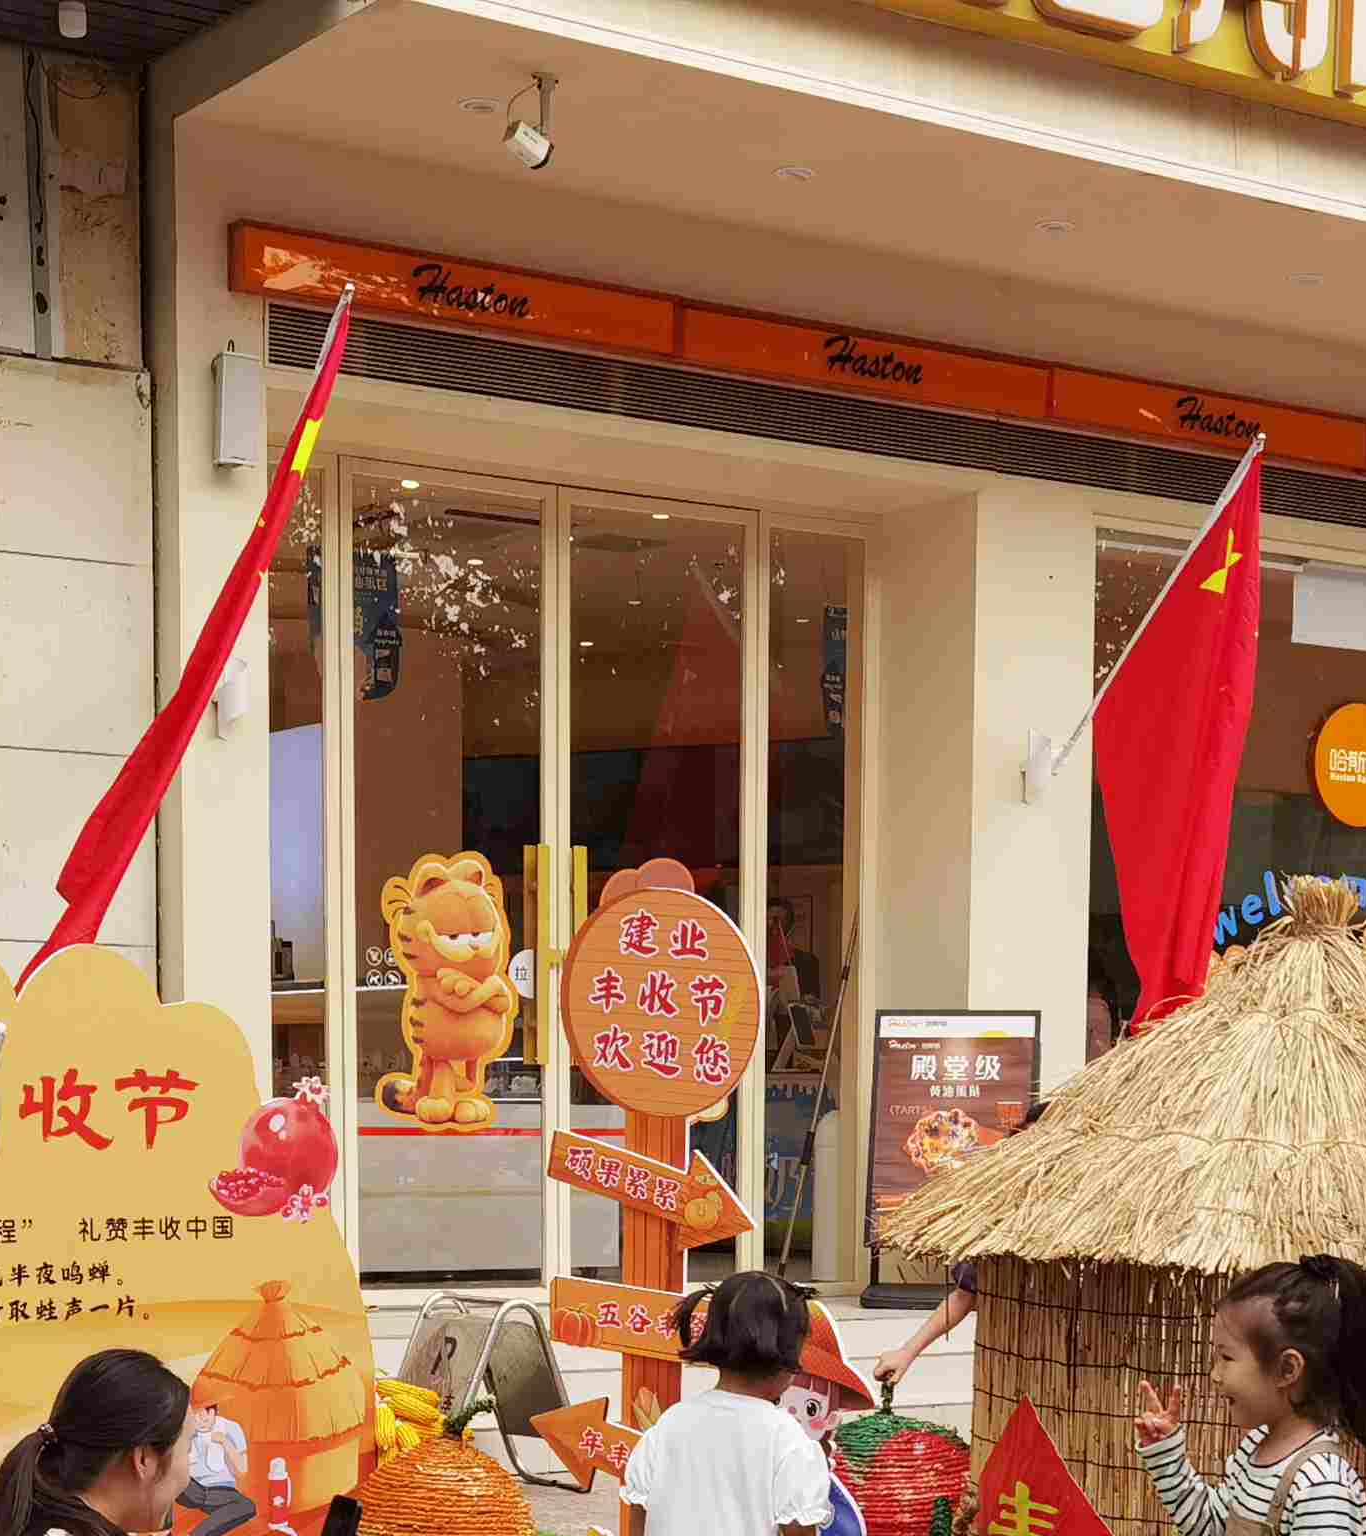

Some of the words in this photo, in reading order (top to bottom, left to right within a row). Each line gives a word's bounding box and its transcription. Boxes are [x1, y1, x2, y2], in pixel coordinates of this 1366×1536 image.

[412, 263, 531, 318] Haston
[823, 336, 924, 385] Haston
[1176, 395, 1262, 440] Haston
[619, 908, 709, 960] 建业
[589, 967, 727, 1026] 丰收节
[593, 1024, 732, 1086] 欢迎您
[909, 1055, 1003, 1081] 殿堂级
[565, 1147, 681, 1211] 硕果累累
[78, 1215, 234, 1243] 礼赞丰收中国
